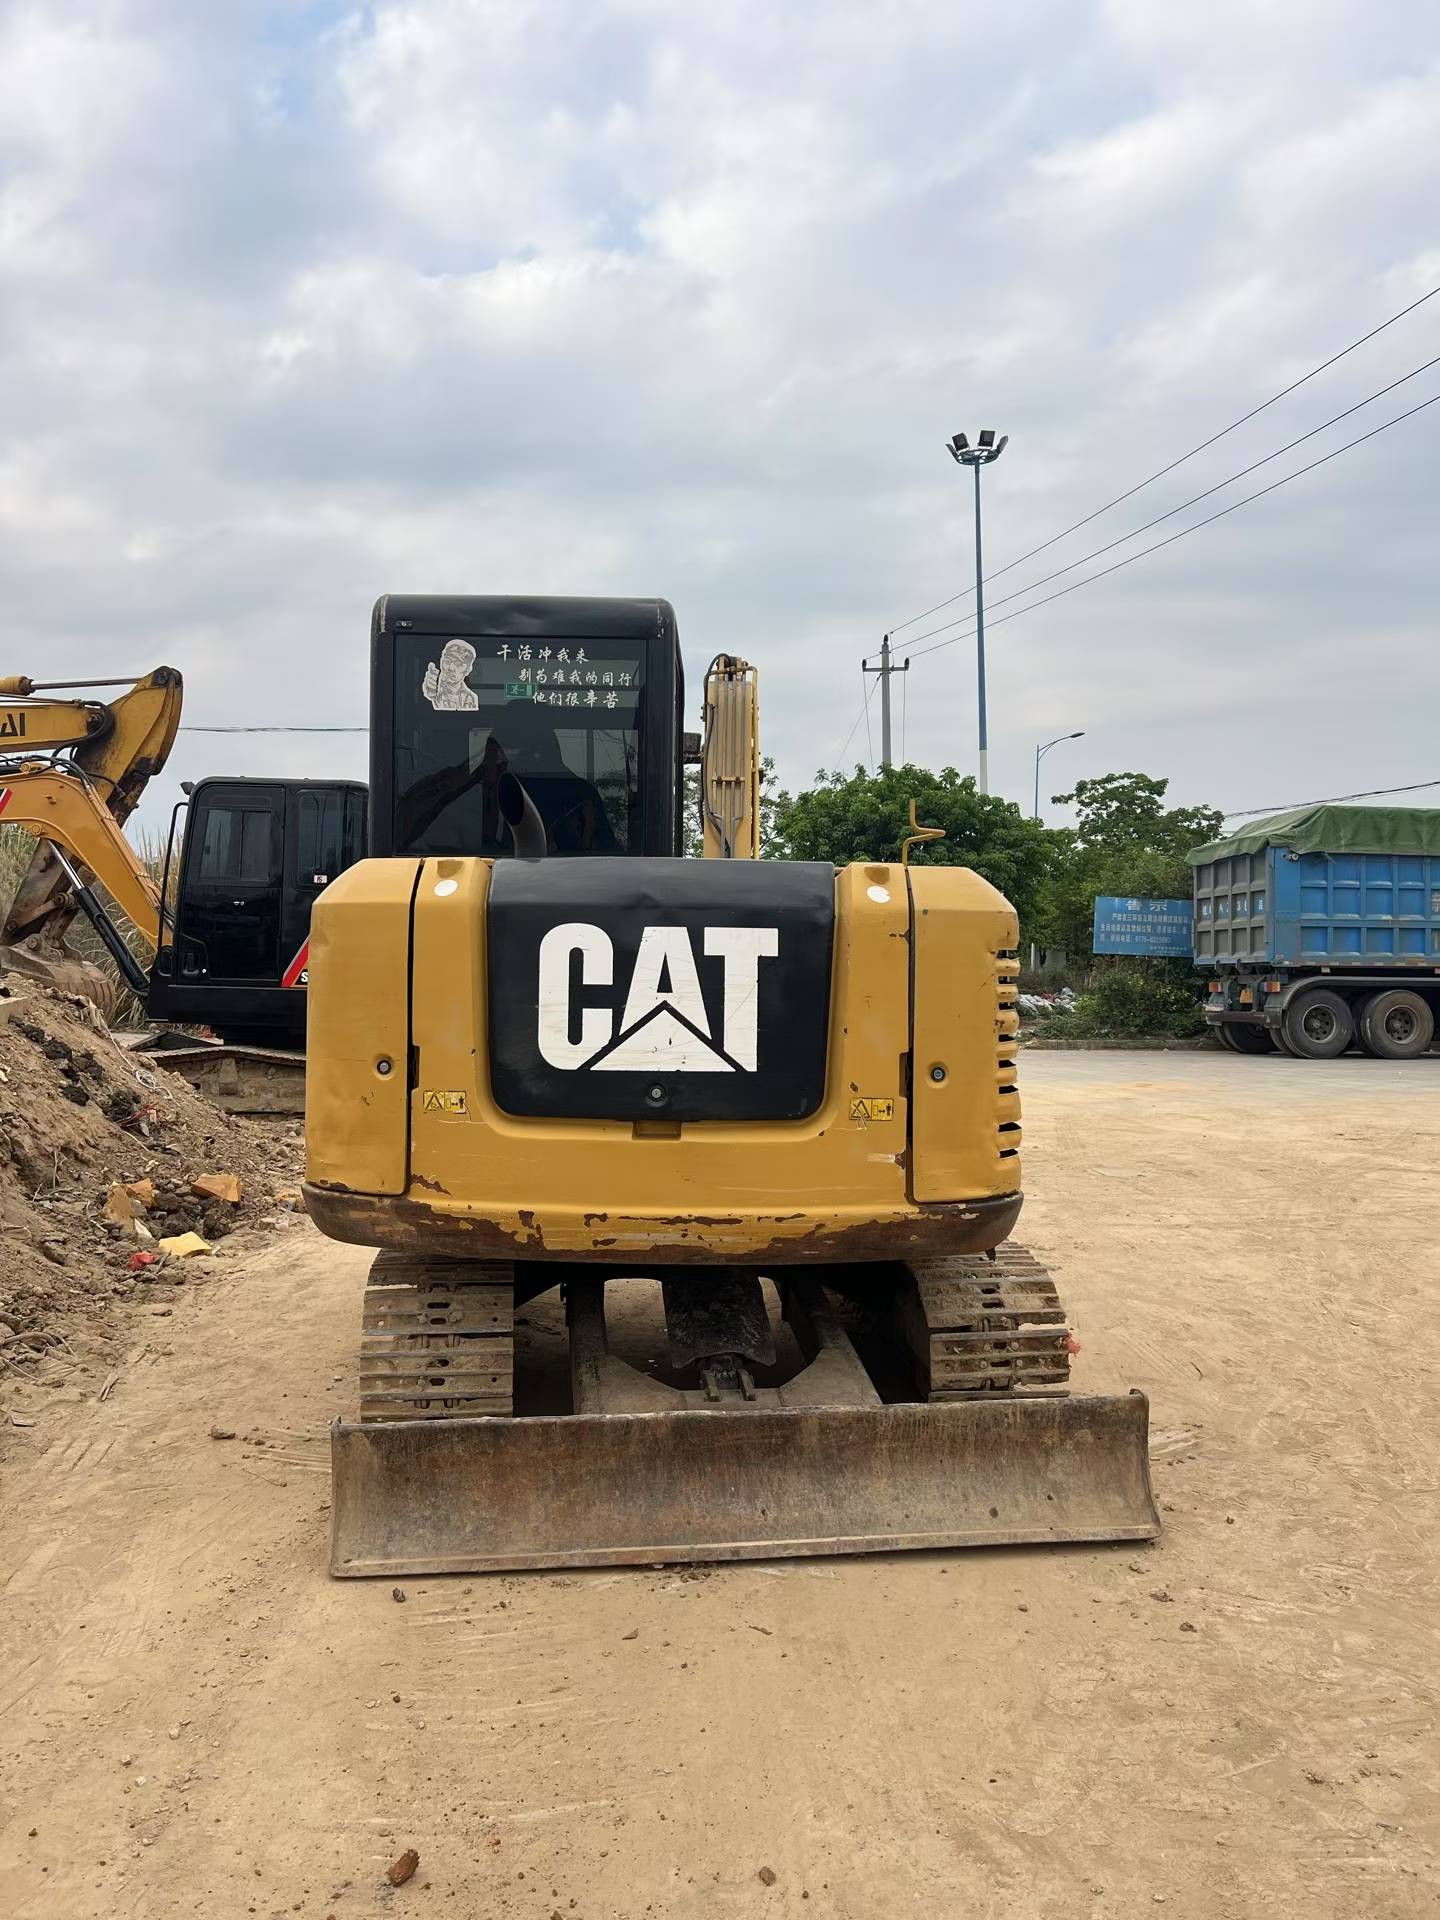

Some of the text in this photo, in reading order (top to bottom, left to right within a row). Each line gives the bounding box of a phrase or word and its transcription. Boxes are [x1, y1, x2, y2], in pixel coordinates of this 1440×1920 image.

[496, 644, 590, 664] 干活冲我来
[518, 667, 632, 687] 别为难我的同行
[532, 689, 619, 709] 他们很辛苦
[538, 922, 779, 1072] CAT
